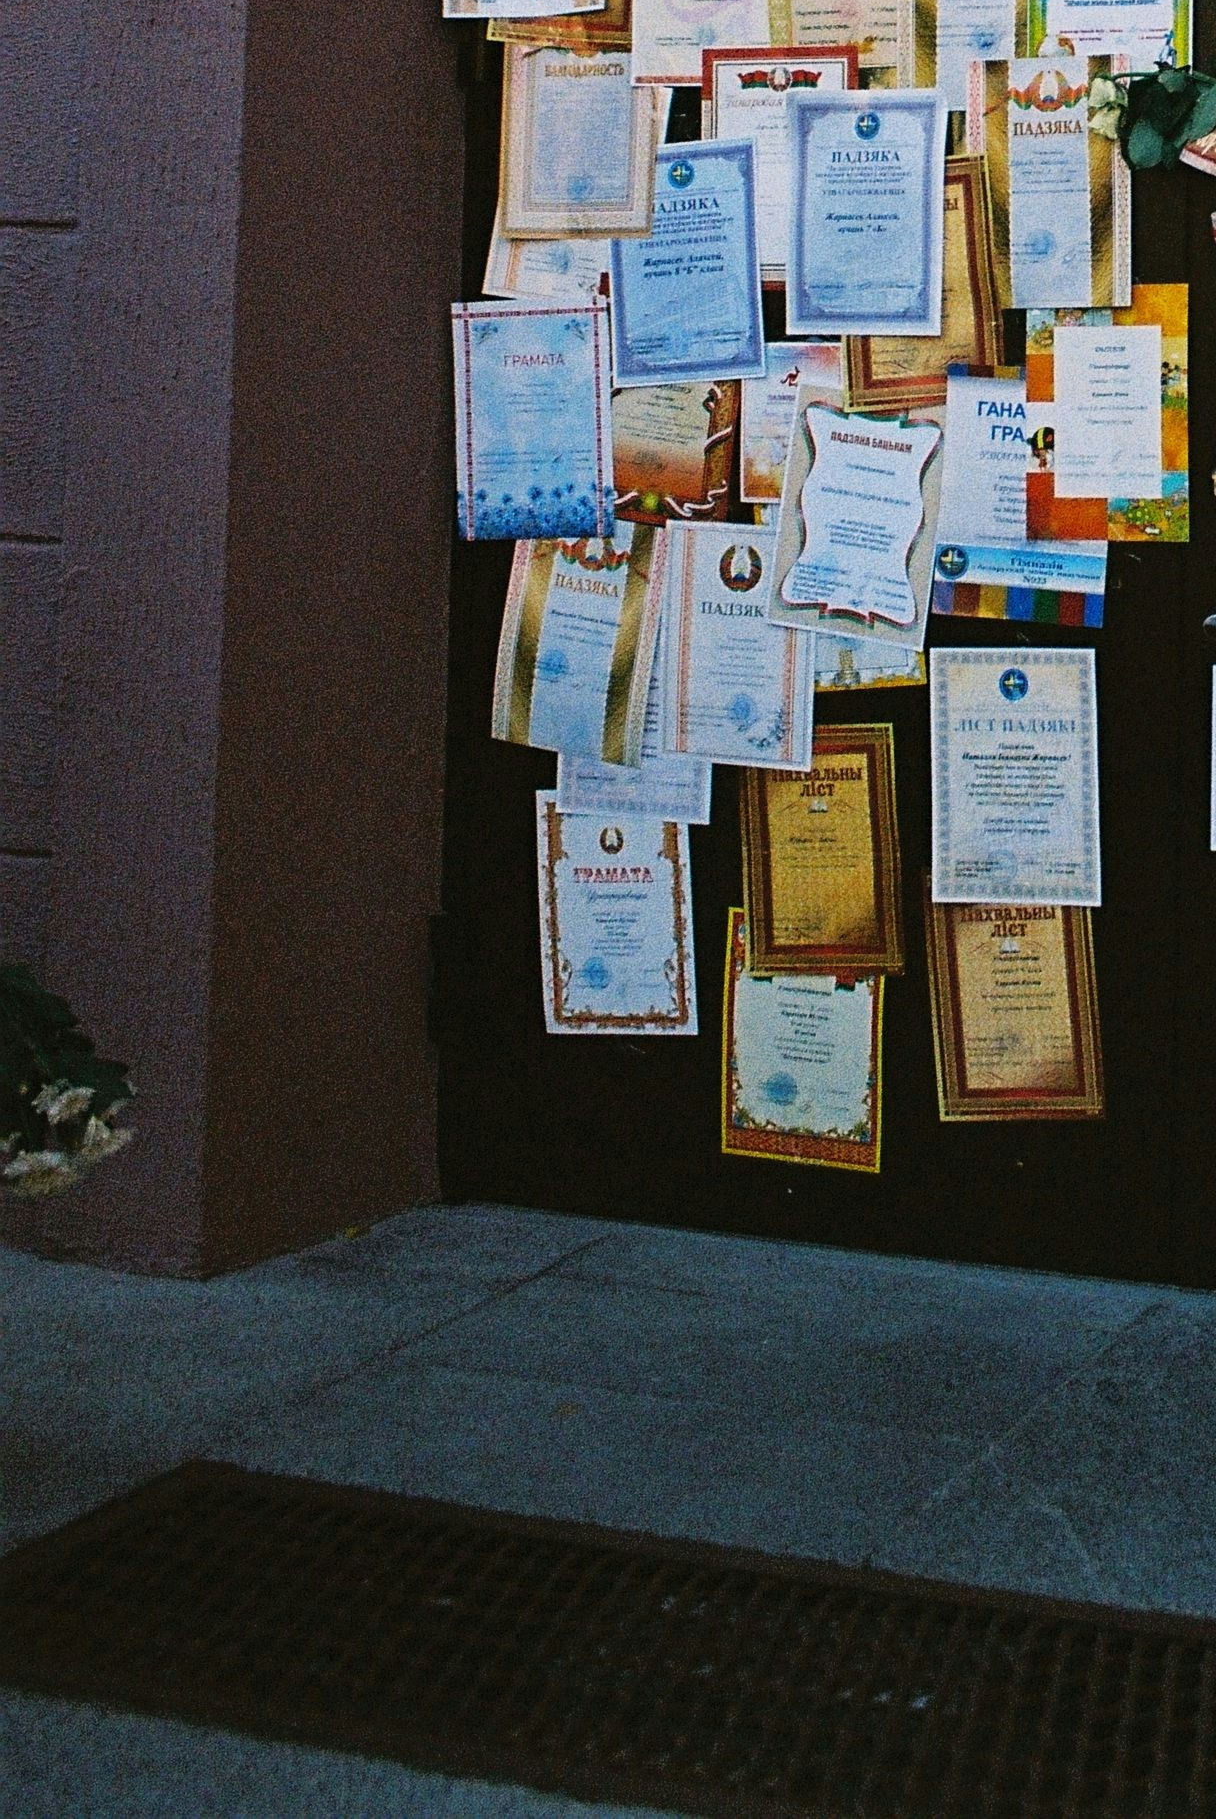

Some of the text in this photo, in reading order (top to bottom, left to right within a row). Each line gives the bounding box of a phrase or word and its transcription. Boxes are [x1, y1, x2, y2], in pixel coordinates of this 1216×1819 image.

[1013, 120, 1083, 137] ПАДЗЯКА
[831, 150, 901, 163] ПАДЗЯКА
[503, 353, 565, 368] ГРАМАТА
[977, 400, 1026, 419] ГАНА
[554, 572, 619, 597] ПАДЗЯКА
[701, 600, 765, 618] ПАДЗЯК
[954, 718, 1076, 733] ЛІСТ ПАДЗЯКІ
[573, 866, 654, 883] ГРАМАТА
